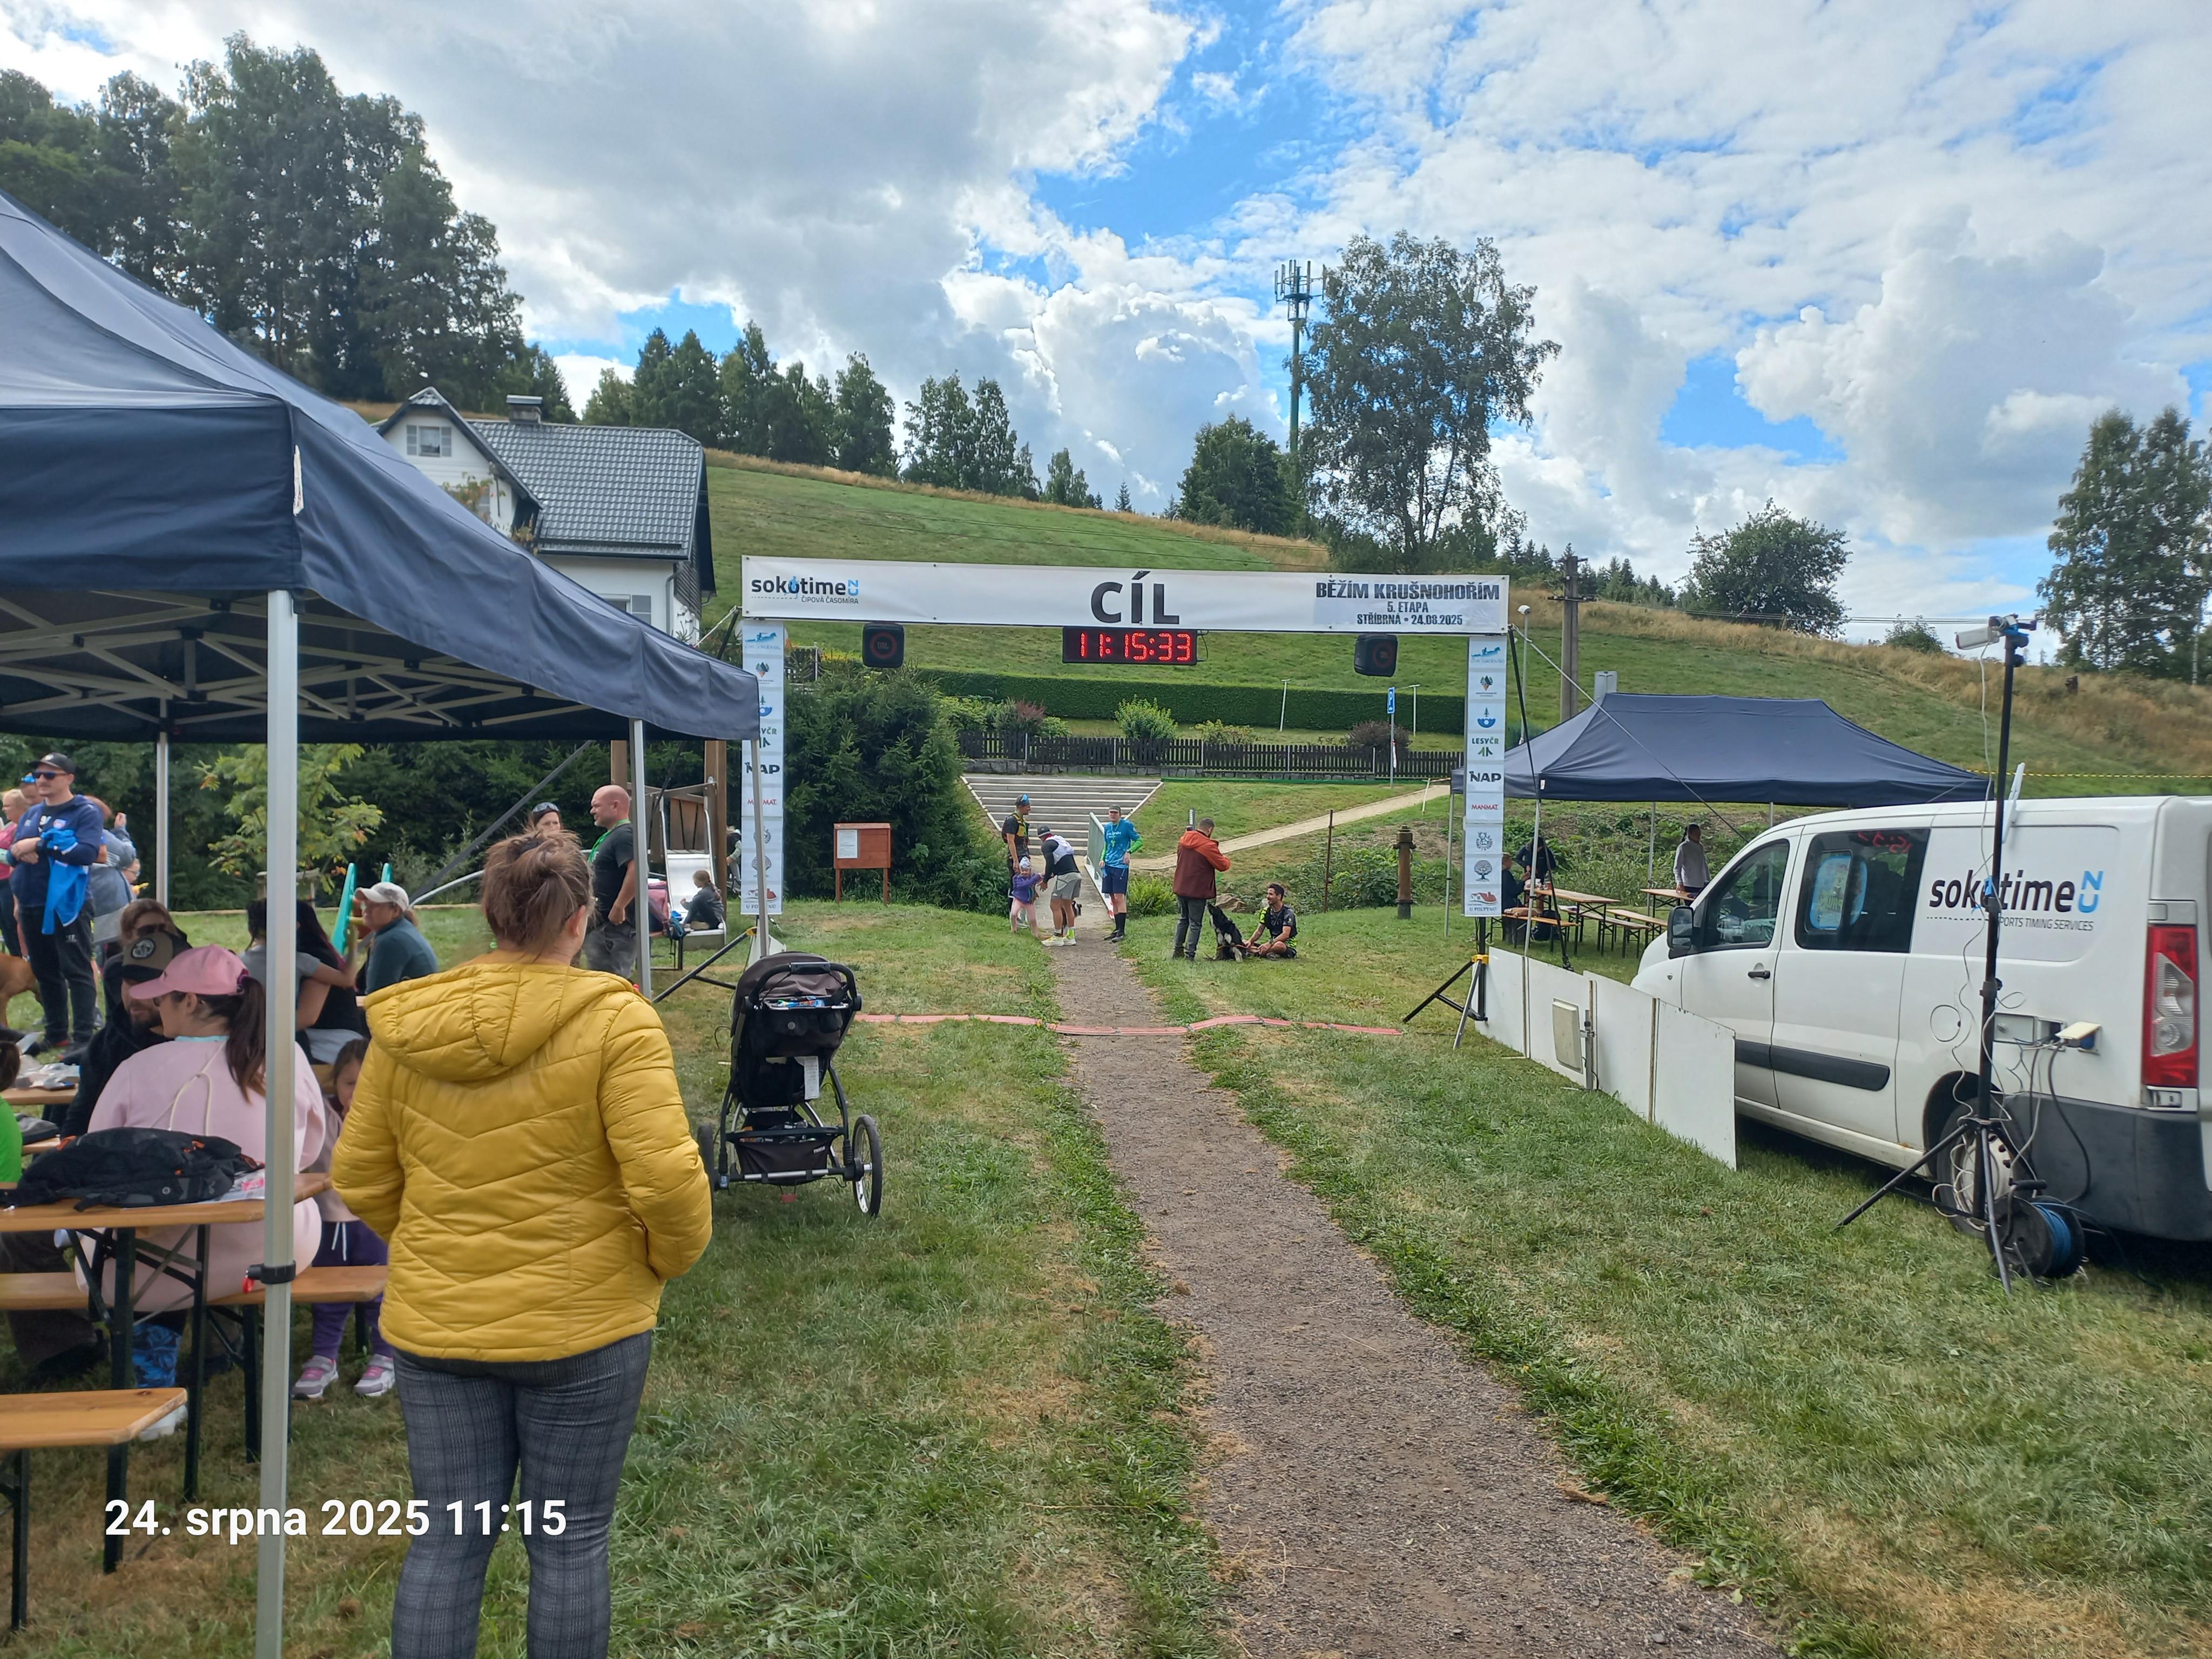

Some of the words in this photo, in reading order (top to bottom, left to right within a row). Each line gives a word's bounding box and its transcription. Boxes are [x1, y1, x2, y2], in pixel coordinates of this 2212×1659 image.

[1316, 579, 1368, 599] BĚŽÍM
[1374, 581, 1500, 600] KRUŠNOHOŘÍM
[801, 595, 825, 603] ČIPOVÁ
[826, 596, 859, 604] ČASOMÍRA
[1091, 570, 1180, 624] CÍL
[1387, 602, 1396, 612] 5.
[1398, 602, 1428, 613] ETAPA
[1357, 612, 1401, 625] STŘÍBRNÁ
[1411, 614, 1462, 625] 24.08.2025
[1080, 631, 1191, 661] 11:15:33
[1469, 771, 1501, 782] NAP
[1999, 916, 2024, 927] PORTS
[2025, 918, 2052, 929] TIMING
[2054, 919, 2094, 931] SERVICES
